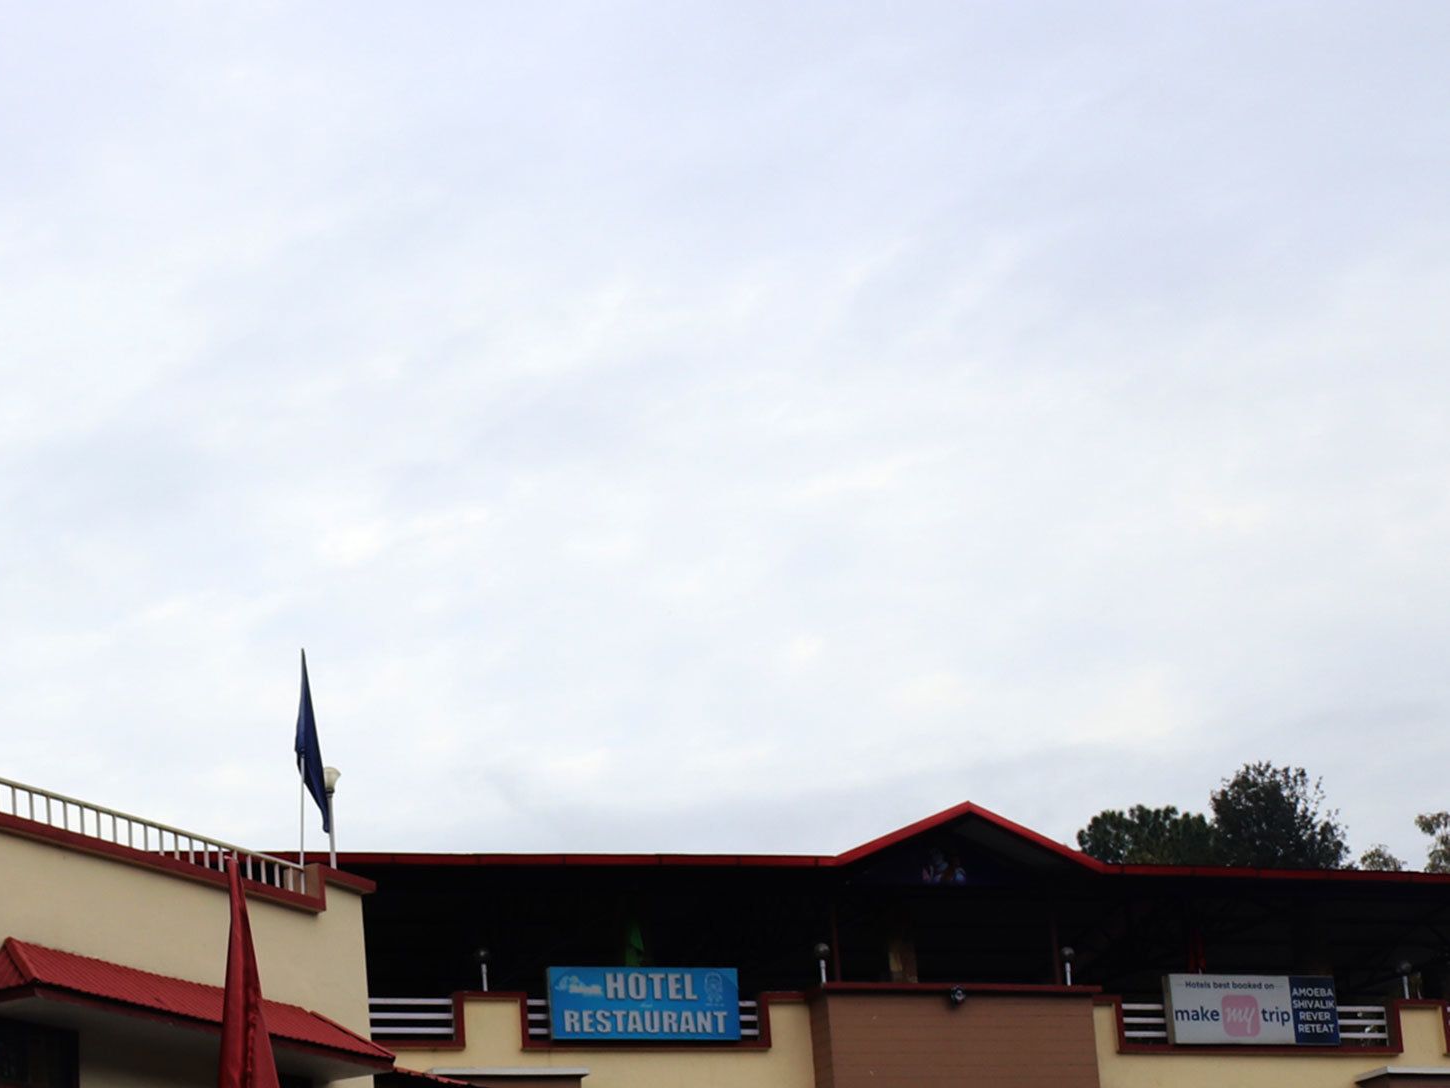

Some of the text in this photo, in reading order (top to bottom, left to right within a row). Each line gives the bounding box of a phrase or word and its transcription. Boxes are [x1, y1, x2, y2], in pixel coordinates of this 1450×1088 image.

[605, 972, 699, 1000] HOTEL
[1213, 981, 1230, 989] best
[1232, 981, 1262, 989] booked
[1292, 987, 1334, 997] AMOEBA
[1292, 1000, 1335, 1010] SHIVALIK
[1174, 1006, 1219, 1021] make
[1261, 1007, 1291, 1025] trip
[1299, 1011, 1331, 1021] REVER
[564, 1009, 728, 1034] RESTAURANT
[1298, 1023, 1334, 1034] RETEAT
